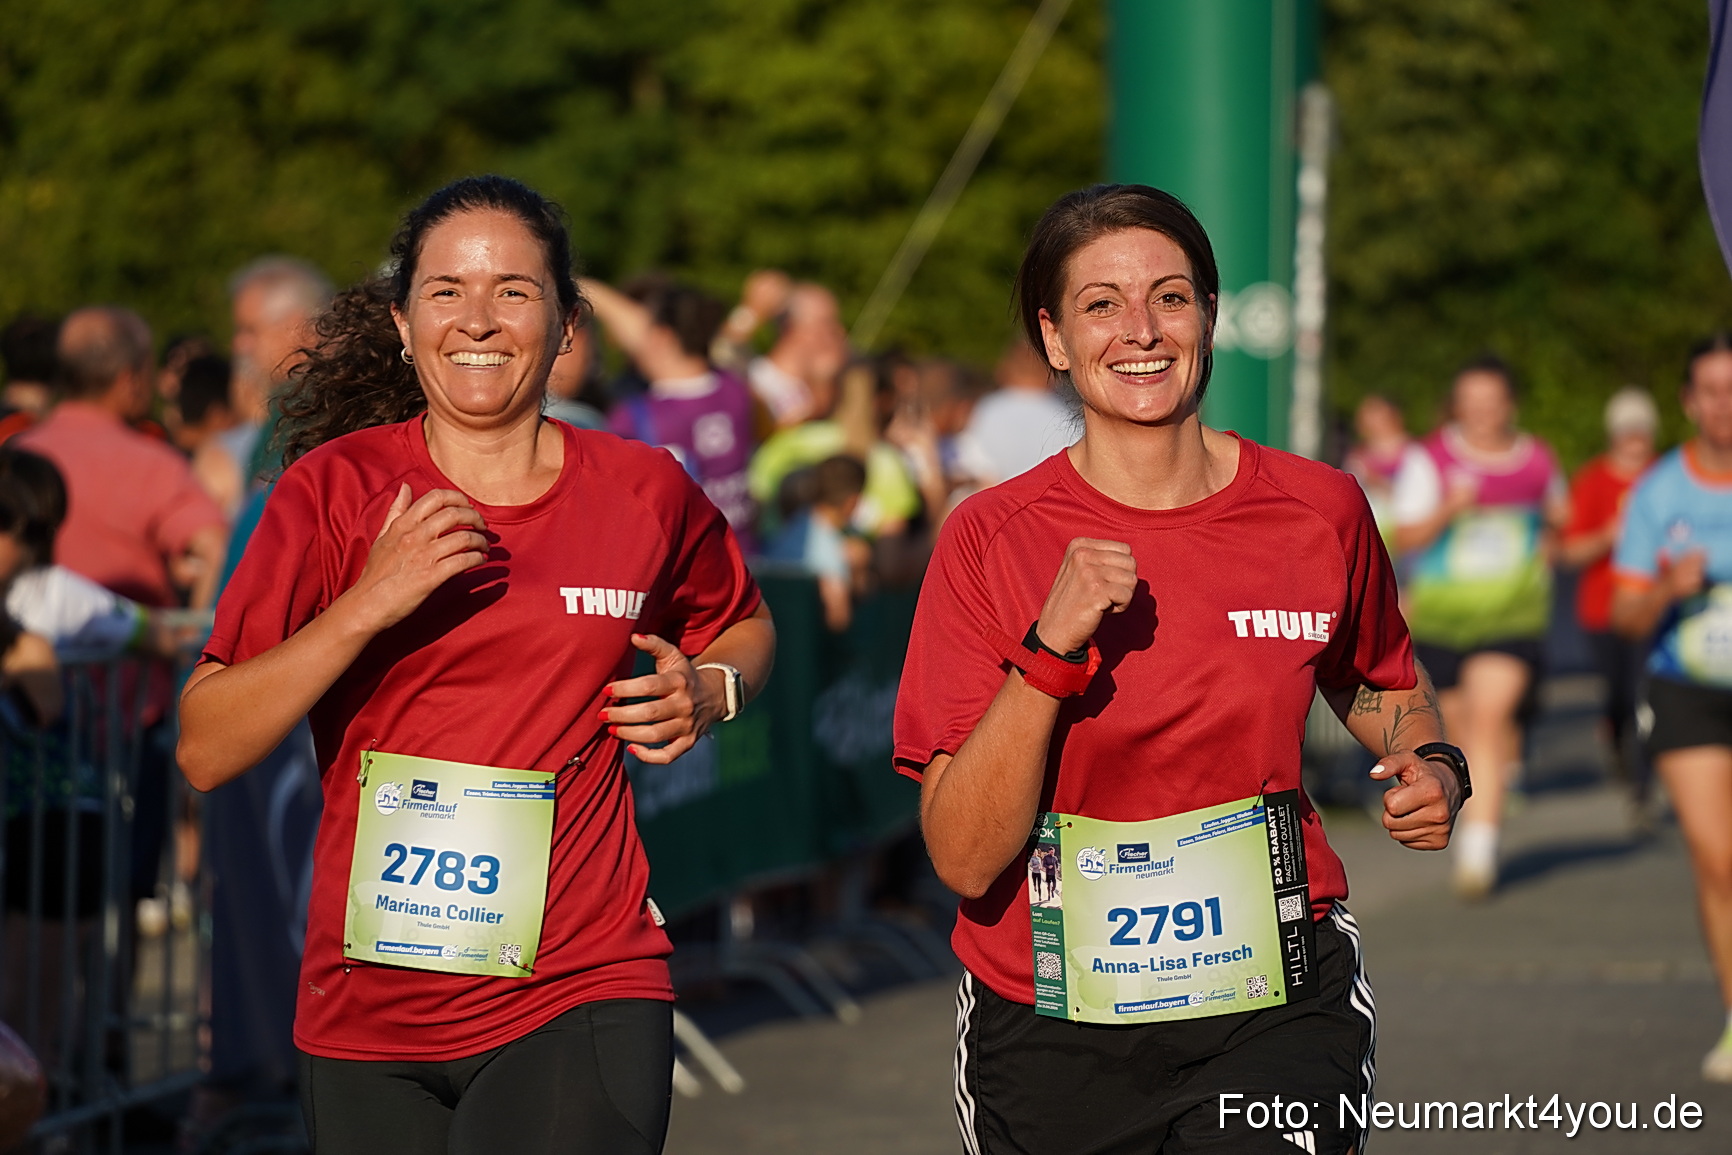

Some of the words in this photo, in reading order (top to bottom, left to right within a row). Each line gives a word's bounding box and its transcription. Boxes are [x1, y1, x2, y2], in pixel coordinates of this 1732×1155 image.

[1228, 610, 1331, 643] THULE
[1307, 632, 1327, 640] SWEDEN
[402, 799, 458, 813] Firmenlauf
[420, 811, 456, 820] neumarkt
[1278, 805, 1288, 841] OUTLET
[1267, 806, 1280, 855] RABATT
[381, 843, 500, 895] 2783
[1109, 856, 1174, 874] Firmenlauf
[1273, 856, 1281, 867] %
[1282, 842, 1292, 882] FACTORY
[1135, 867, 1174, 880] neumarkt
[1274, 868, 1283, 885] 20
[375, 894, 441, 918] Mariana
[446, 904, 504, 925] Collier
[417, 921, 432, 929] Thule
[432, 923, 450, 931] GmbH
[1107, 897, 1223, 946] 2791
[378, 943, 440, 956] firmenlauf.bayern
[1286, 925, 1304, 987] HILTL
[1092, 956, 1188, 974] Anna-Lisa
[1192, 944, 1253, 968] Fersch
[1174, 974, 1192, 982] GmbH
[1205, 991, 1236, 1002] Firmenlauf
[1118, 998, 1186, 1013] firmenlauf.bayern
